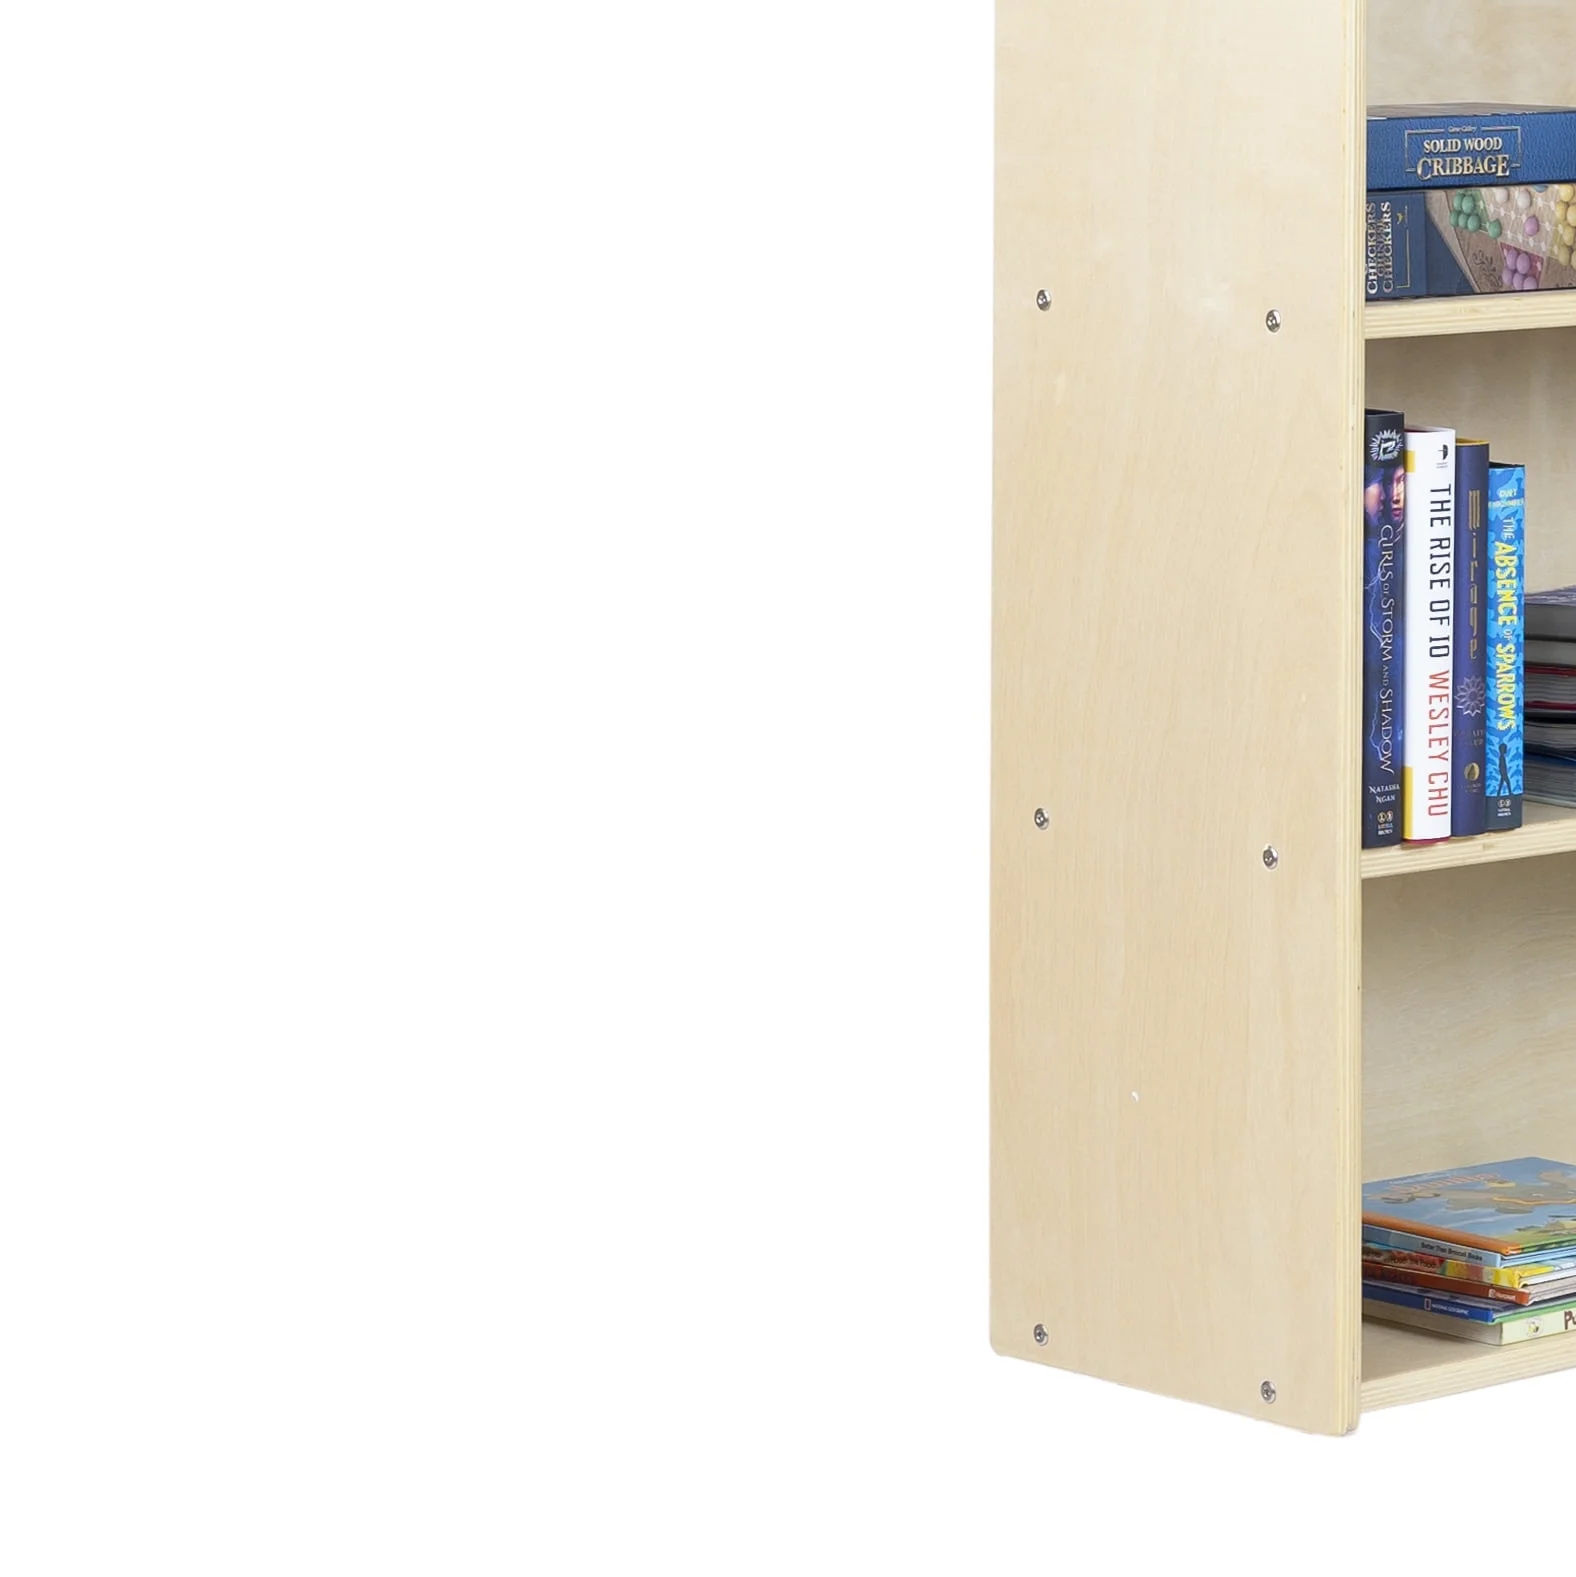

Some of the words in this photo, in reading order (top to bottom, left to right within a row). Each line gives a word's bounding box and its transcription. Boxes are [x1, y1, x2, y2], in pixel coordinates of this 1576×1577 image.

[1417, 154, 1510, 180] CRIBBAGE
[1423, 138, 1462, 154] SOLID
[1463, 136, 1502, 152] WOOD
[1366, 202, 1378, 294] CHECKERS
[1381, 201, 1393, 292] CHECKERS
[1429, 484, 1451, 527] THE
[1502, 516, 1515, 540] THE
[1378, 525, 1393, 579] GIRLS
[1429, 537, 1450, 590] RISE
[1494, 541, 1519, 626] ABSENCE
[1381, 599, 1394, 659] STORM
[1429, 600, 1450, 627] OF
[1496, 643, 1516, 731] SPARROWS
[1380, 688, 1394, 775] SHADOW
[1428, 670, 1450, 761] WESLEY
[1369, 783, 1400, 794] NATASHA
[1376, 794, 1395, 804] NGAN
[1428, 771, 1449, 817] CHU
